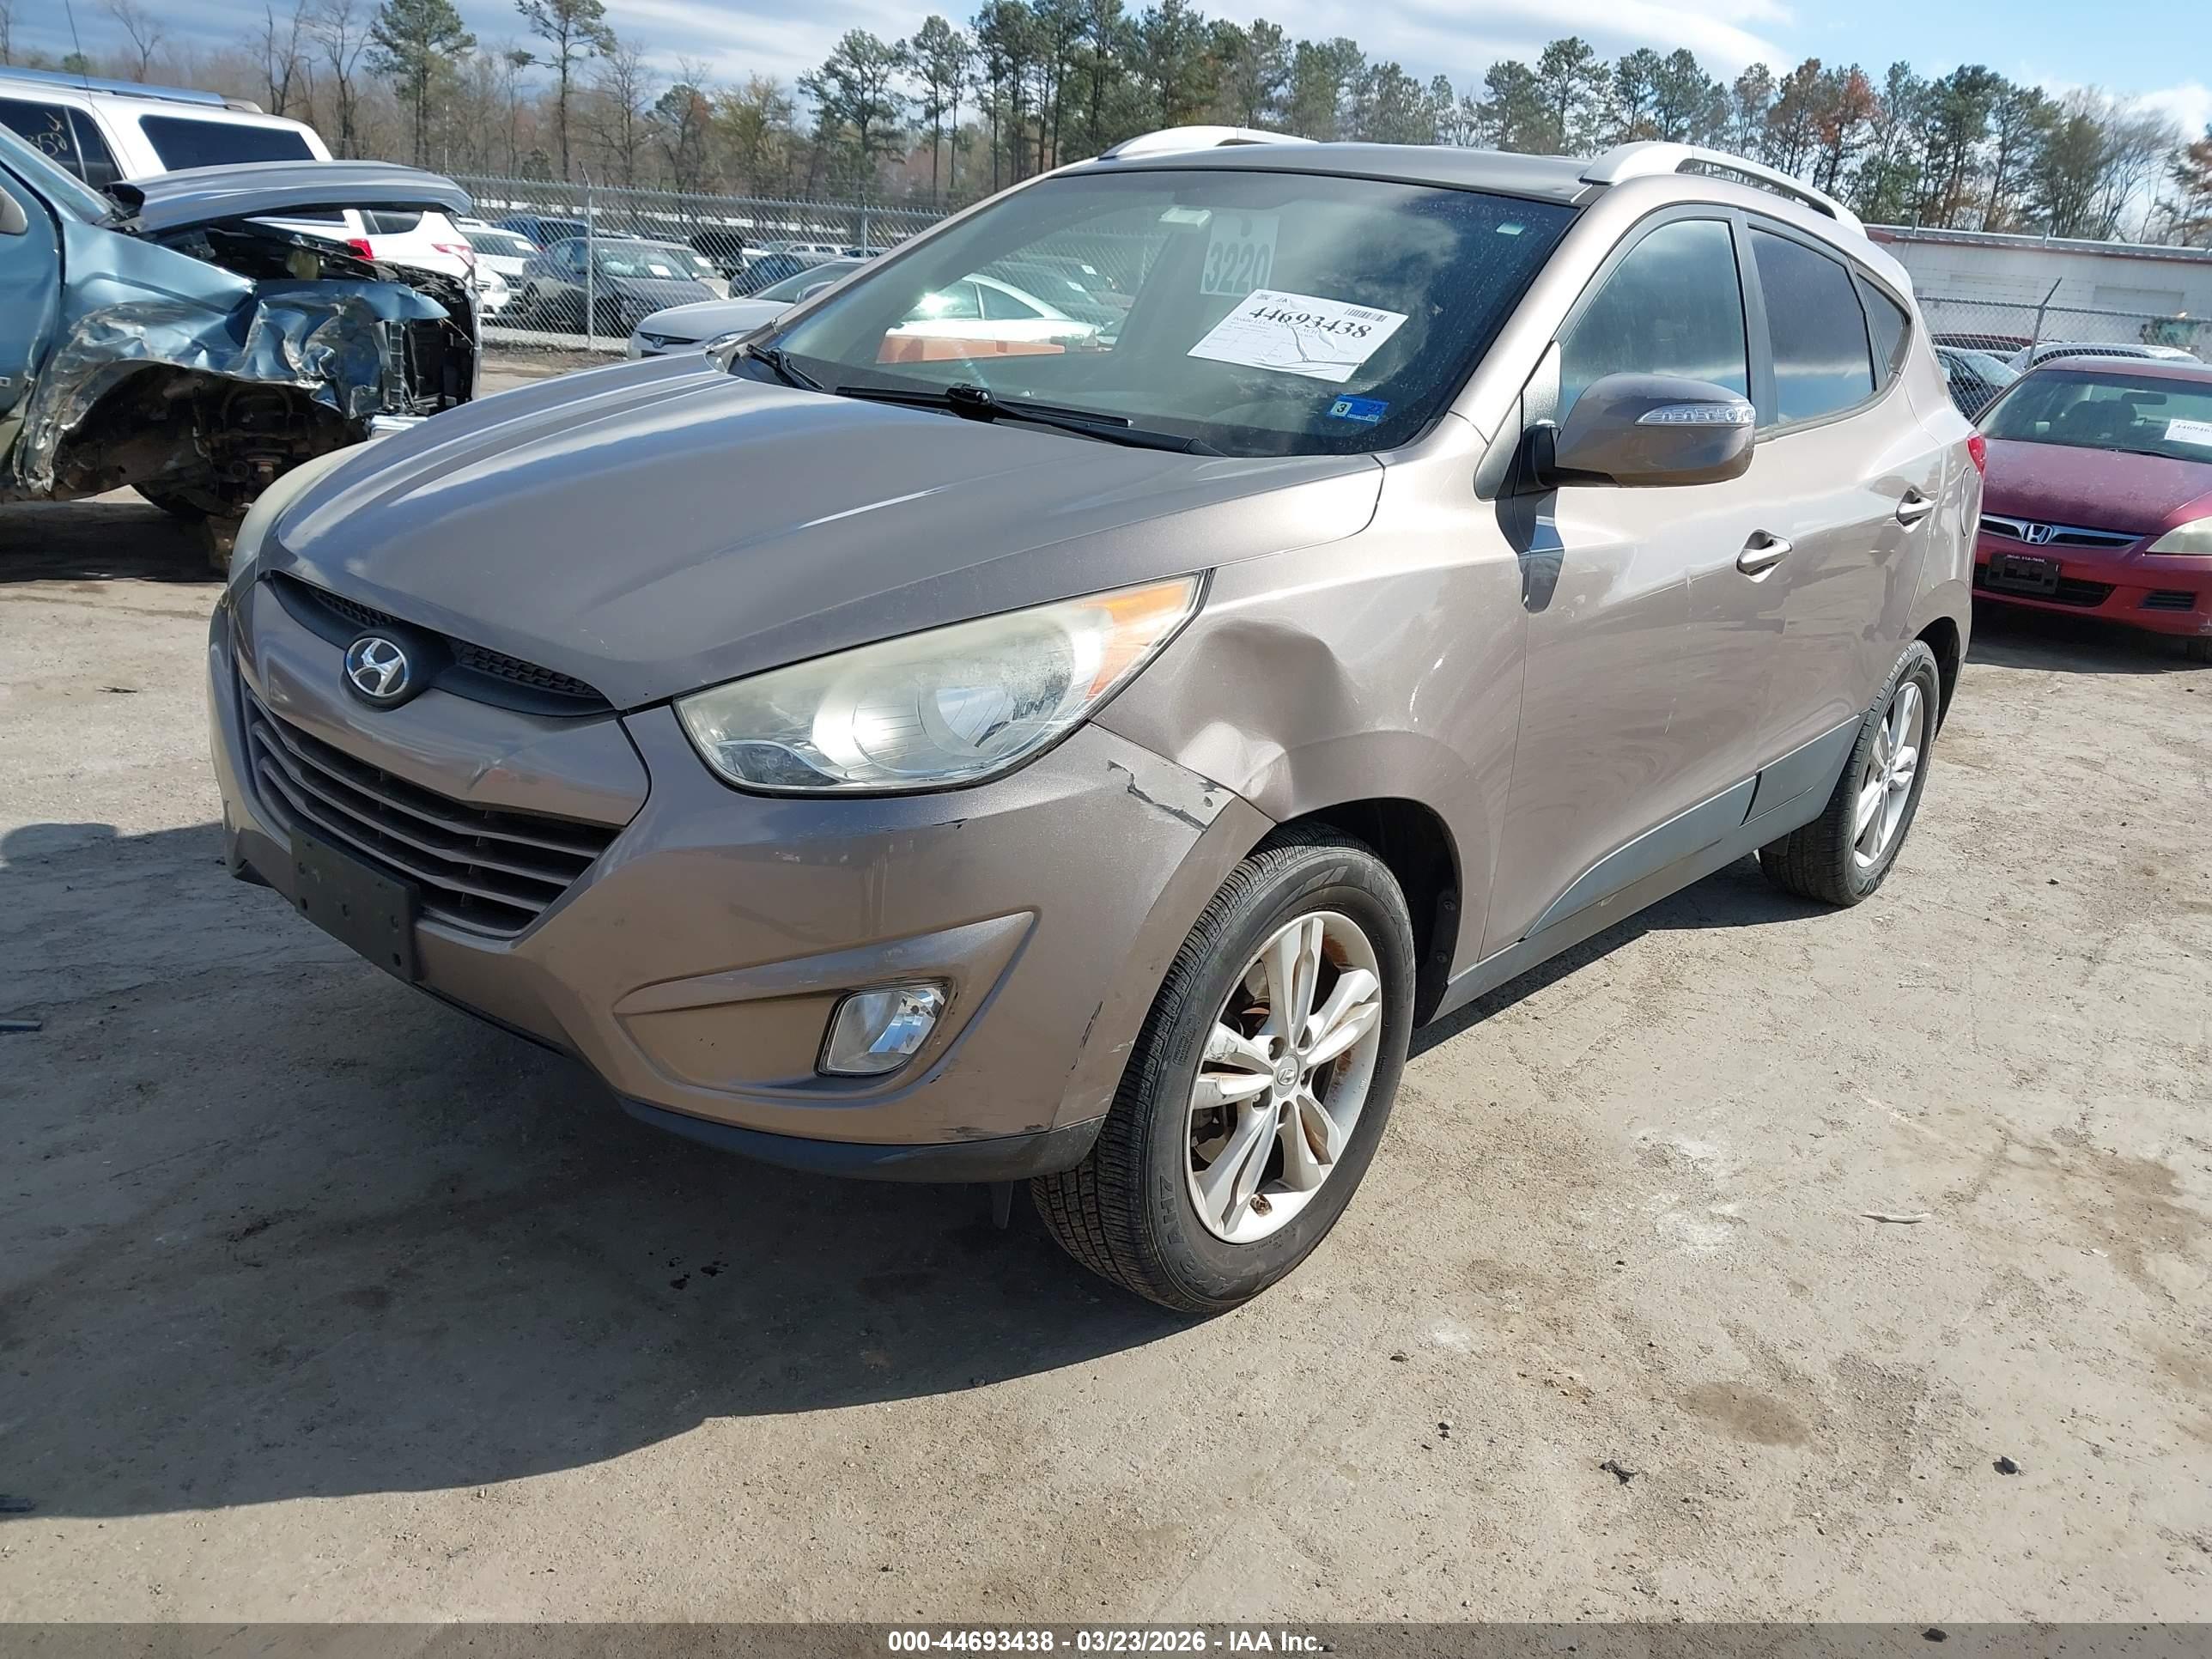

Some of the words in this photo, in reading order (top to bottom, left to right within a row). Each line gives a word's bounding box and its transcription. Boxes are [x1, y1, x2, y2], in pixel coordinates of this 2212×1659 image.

[1205, 241, 1270, 295] 3220
[1249, 306, 1372, 338] 44693438
[1336, 403, 1347, 413] 3
[2175, 423, 2212, 434] 446946
